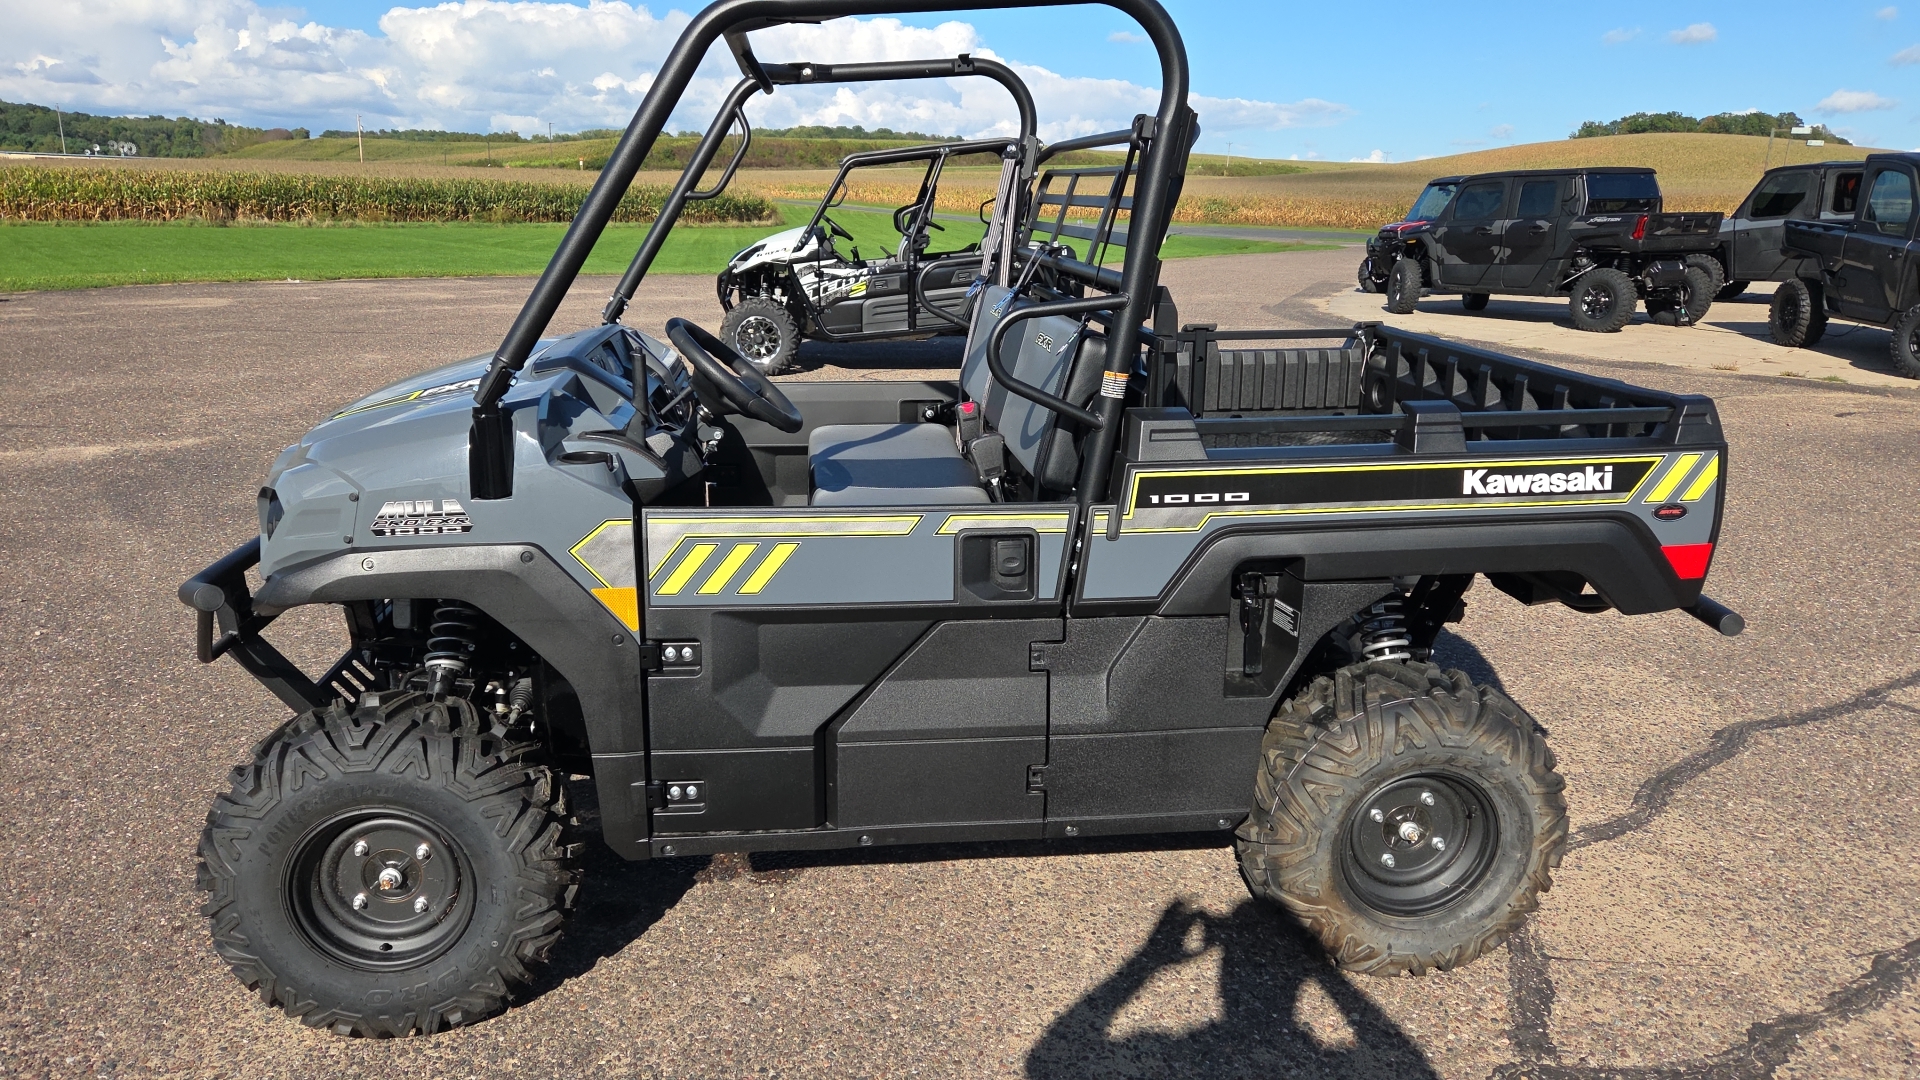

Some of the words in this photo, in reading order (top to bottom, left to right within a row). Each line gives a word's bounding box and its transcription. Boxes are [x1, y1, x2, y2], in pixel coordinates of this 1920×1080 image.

[1462, 465, 1613, 495] Kawasaki
[1149, 492, 1250, 504] 1000
[384, 526, 462, 536] 1000
